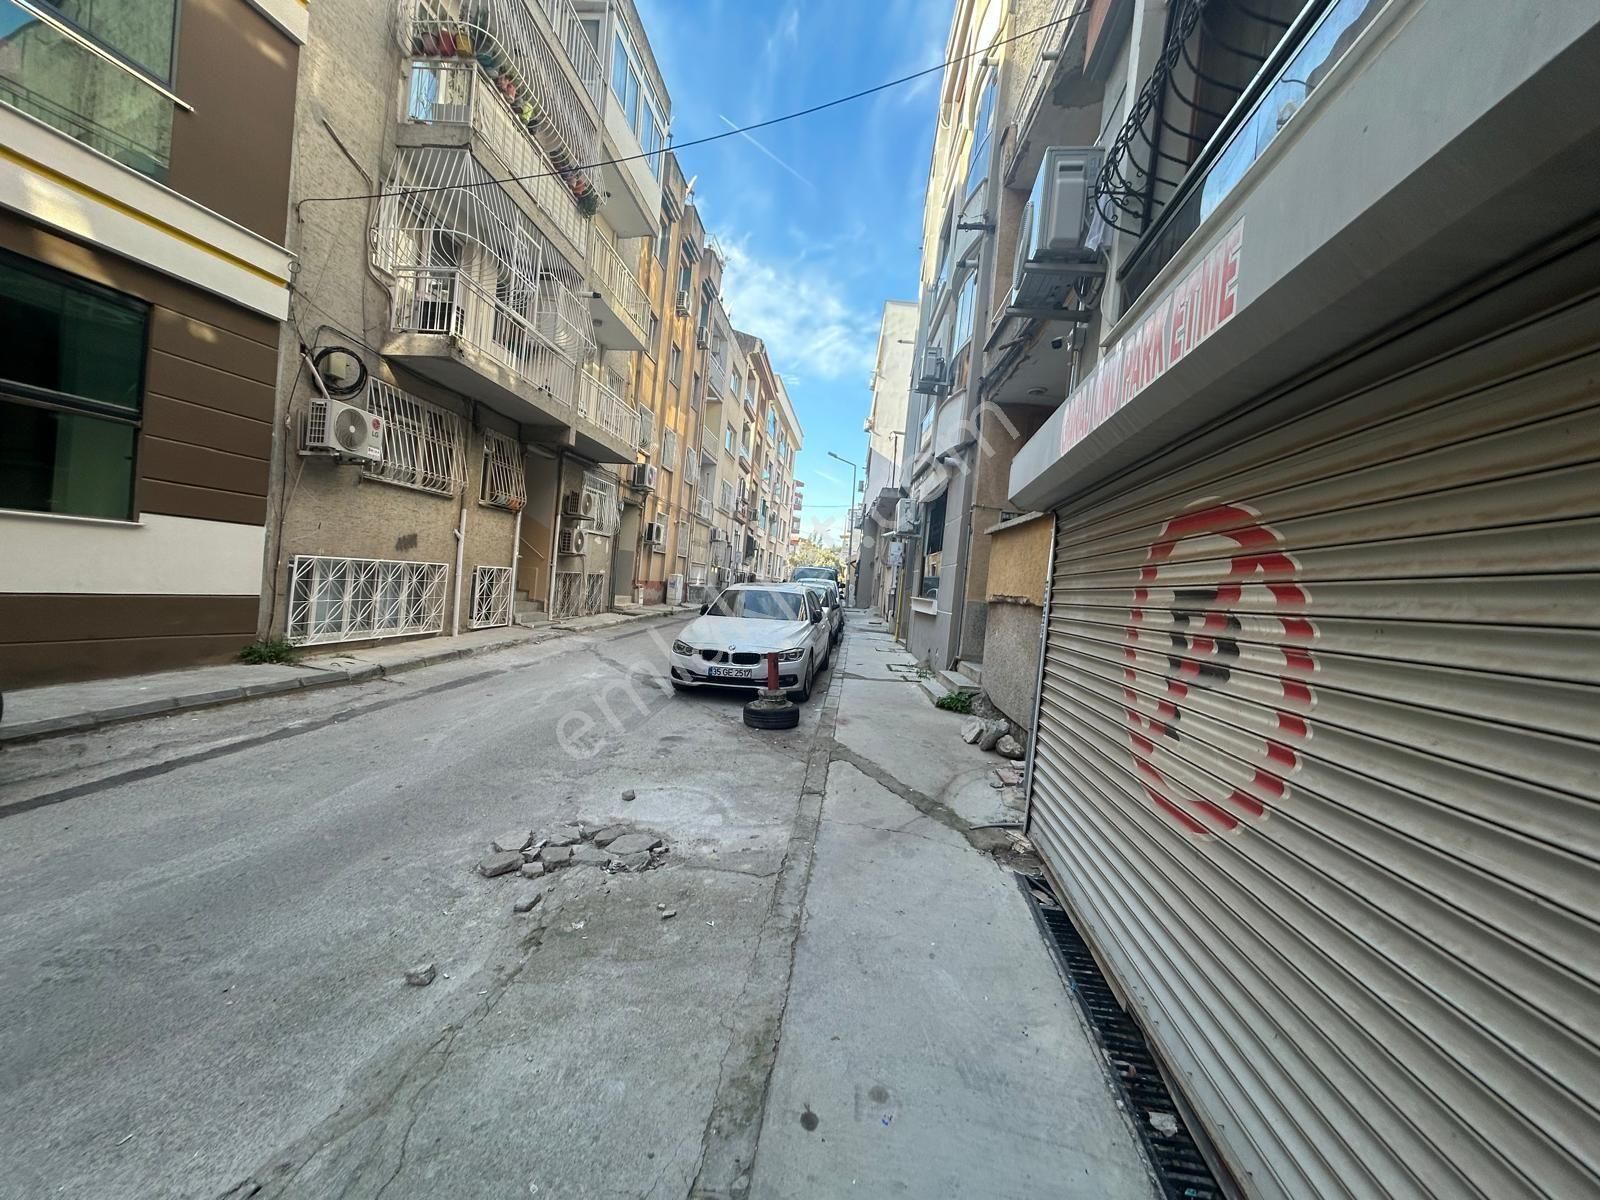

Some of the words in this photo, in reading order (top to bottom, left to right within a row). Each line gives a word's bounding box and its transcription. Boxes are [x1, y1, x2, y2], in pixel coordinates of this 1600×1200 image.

[1120, 293, 1172, 409] PARK
[1167, 216, 1245, 370] ETME
[371, 430, 379, 438] LG
[712, 668, 722, 676] 35
[722, 668, 733, 676] GE
